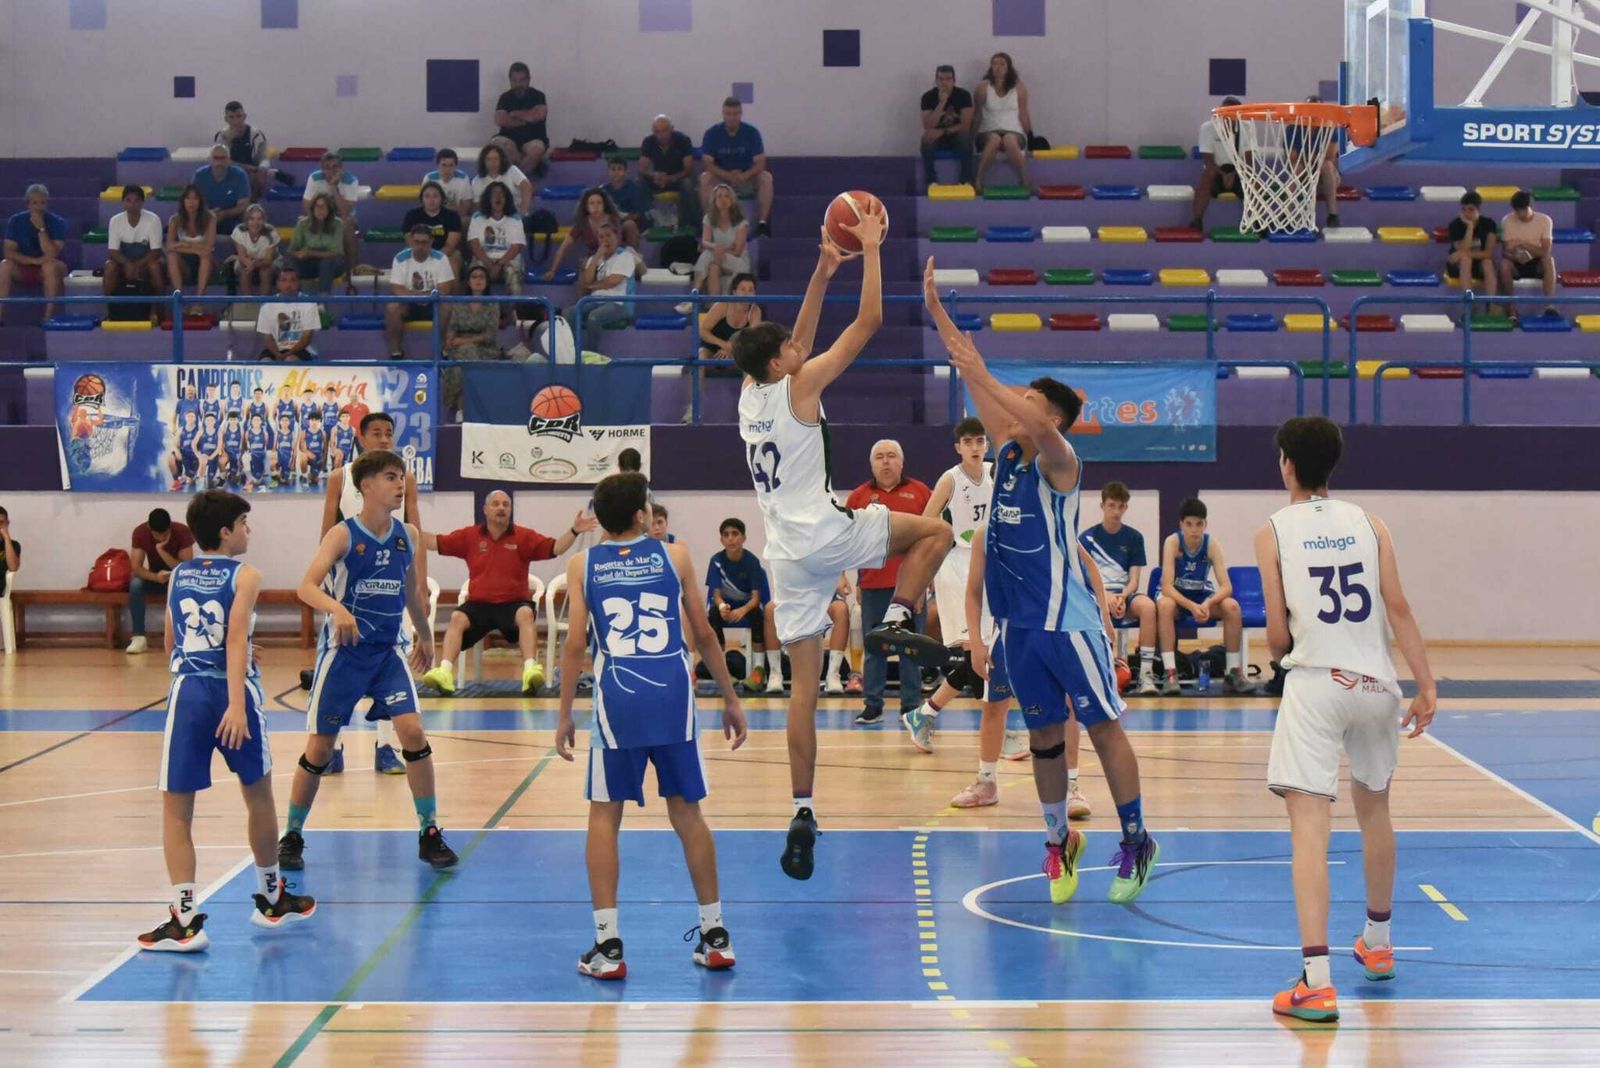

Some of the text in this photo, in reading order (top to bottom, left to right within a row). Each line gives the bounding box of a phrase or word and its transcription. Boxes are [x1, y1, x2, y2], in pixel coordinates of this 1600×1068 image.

[1463, 122, 1546, 142] SPORT
[530, 412, 580, 432] CDR
[608, 428, 646, 438] HORME
[749, 441, 782, 493] 42
[972, 503, 987, 522] 37
[1303, 535, 1356, 551] málaga
[375, 549, 391, 565] 22
[593, 555, 650, 572] Roquetas de Mar
[1307, 561, 1372, 625] 35
[601, 591, 669, 657] 25
[385, 690, 408, 706] 22
[265, 871, 278, 894] FILA
[180, 889, 193, 914] FILA
